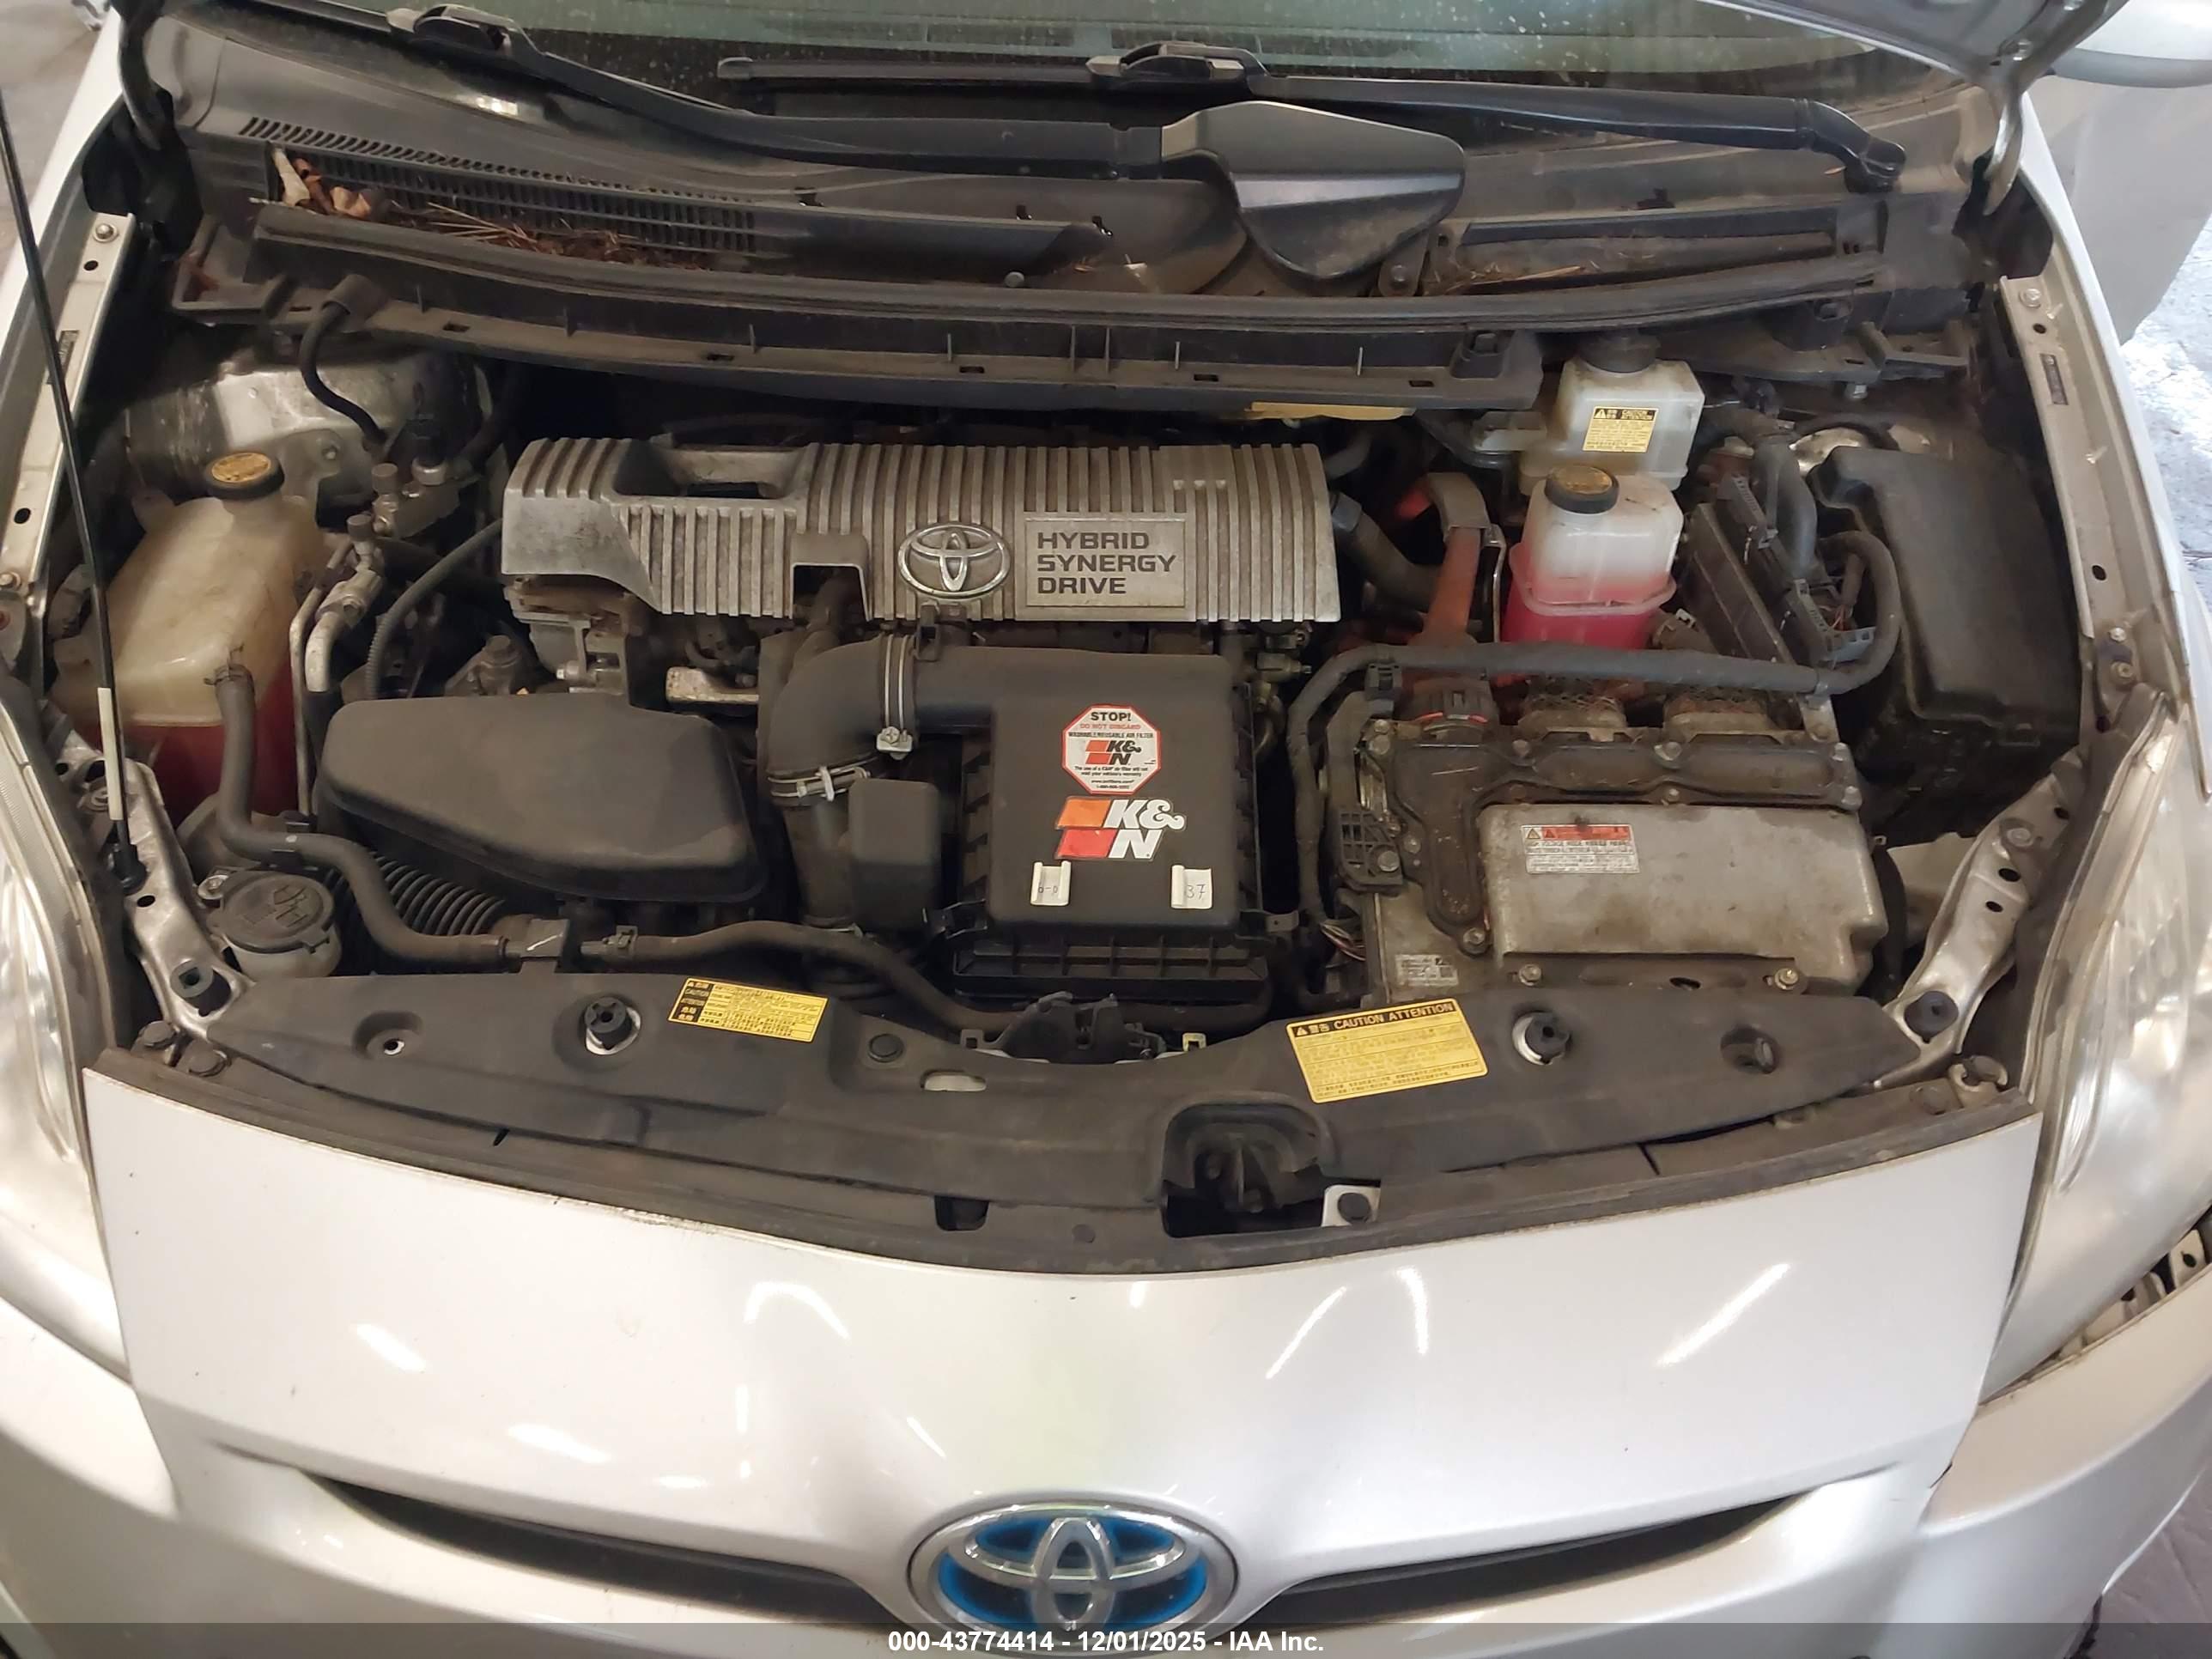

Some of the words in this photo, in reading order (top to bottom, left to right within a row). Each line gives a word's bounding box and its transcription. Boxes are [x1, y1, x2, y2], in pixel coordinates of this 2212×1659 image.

[1037, 532, 1150, 550] HYBRID
[1037, 554, 1176, 572] SYNERGY
[1037, 577, 1127, 594] DRIVE
[1091, 712, 1132, 721] STOP!
[1333, 1014, 1384, 1030] CAUTION
[1388, 1002, 1454, 1022] ATTENTION
